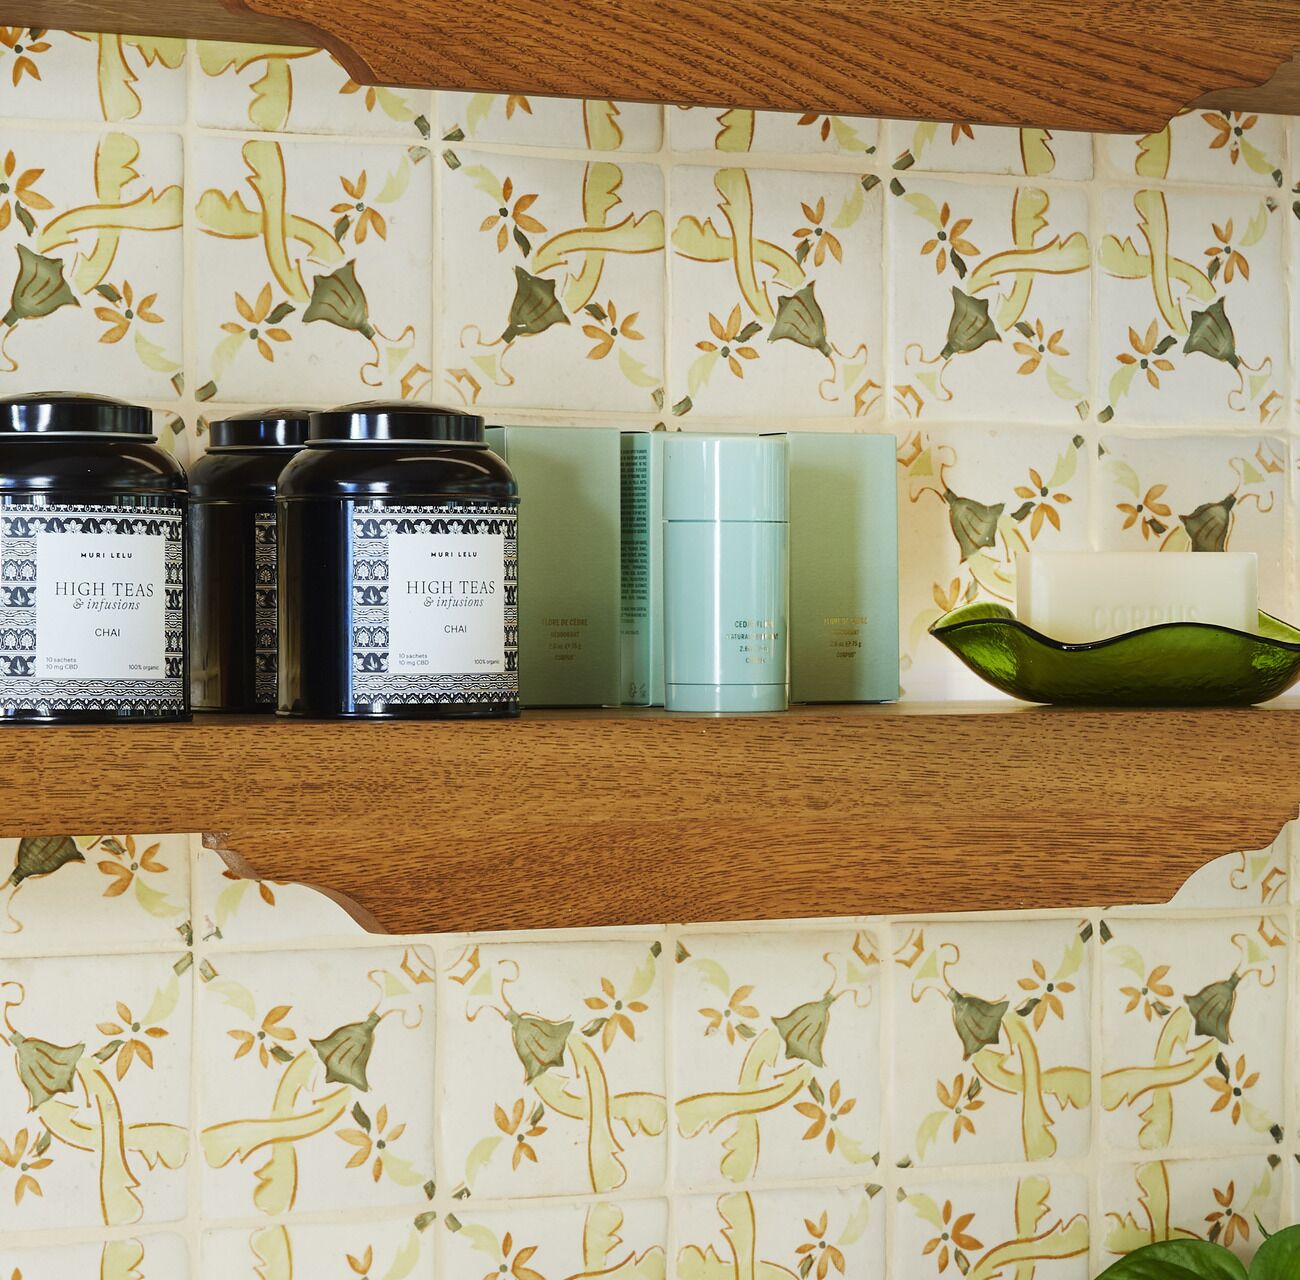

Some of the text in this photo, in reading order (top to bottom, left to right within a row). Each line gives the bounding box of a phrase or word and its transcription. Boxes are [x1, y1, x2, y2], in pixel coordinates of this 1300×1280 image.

[55, 581, 154, 598] HIGH TEAS
[407, 580, 495, 595] HIGH TEAS
[73, 598, 141, 613] & infusions
[423, 596, 484, 610] & infusions
[94, 628, 121, 637] CHAI
[444, 624, 467, 634] CHAI
